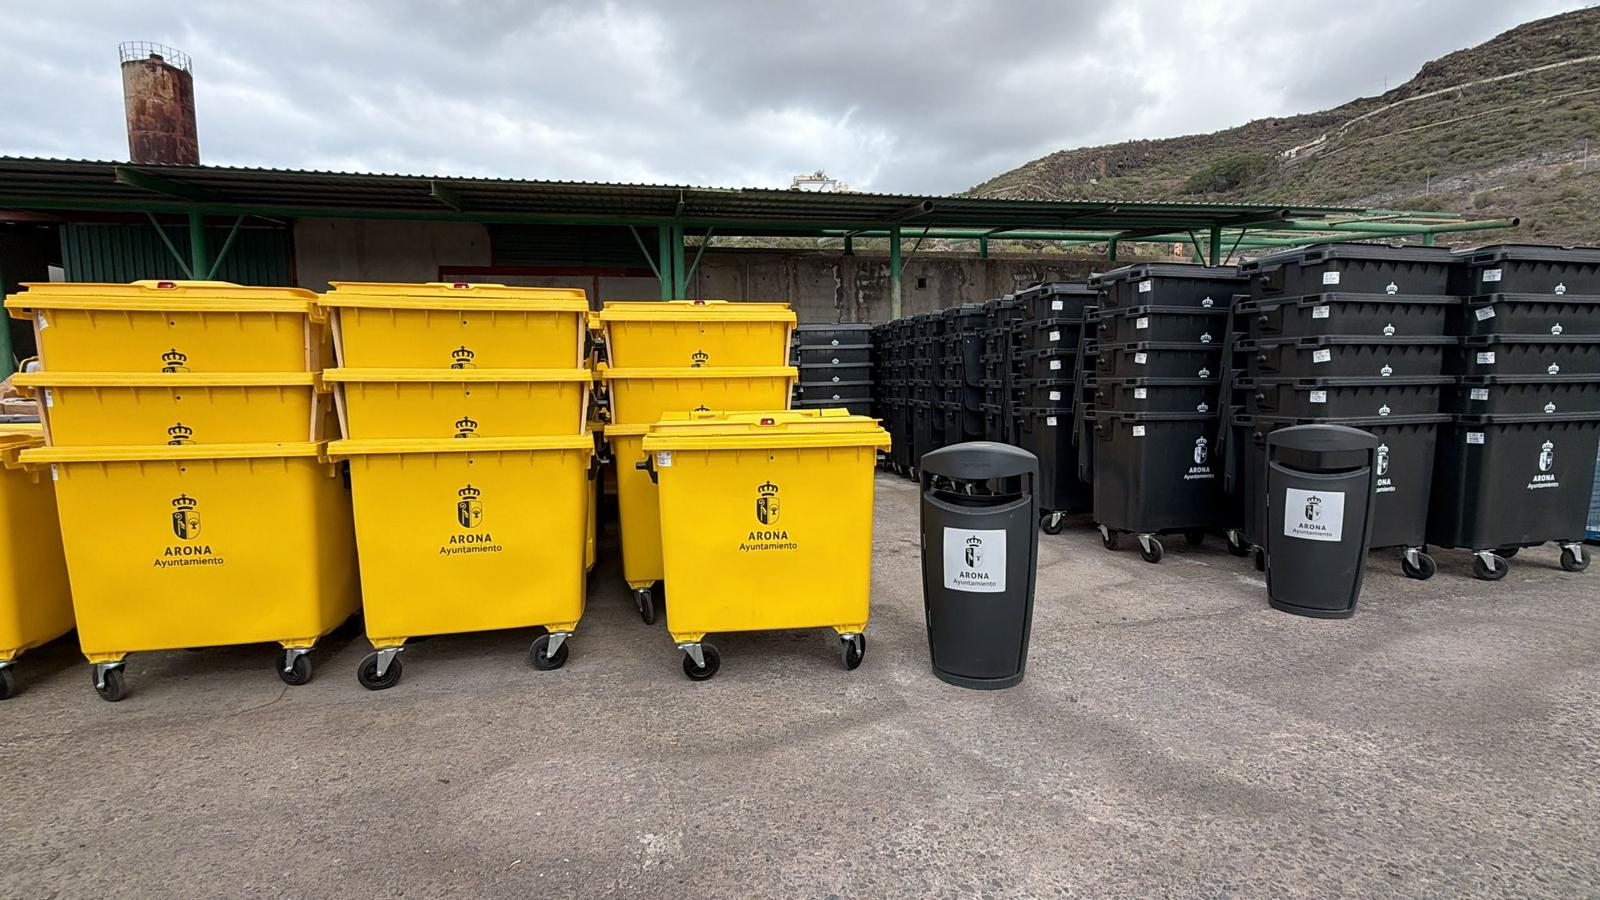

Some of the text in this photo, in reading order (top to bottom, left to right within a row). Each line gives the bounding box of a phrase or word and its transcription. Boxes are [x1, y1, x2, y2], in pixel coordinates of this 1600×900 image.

[1298, 522, 1327, 531] ARONA
[748, 531, 788, 540] ARONA
[1292, 528, 1333, 537] Ayuntamiento
[449, 534, 492, 544] ARONA
[164, 546, 212, 556] ARONA
[440, 545, 502, 556] Ayuntamiento
[739, 542, 797, 552] Ayuntamiento
[154, 557, 224, 568] Ayuntamiento
[959, 571, 990, 580] ARONA
[953, 578, 997, 587] Ayuntamiento
